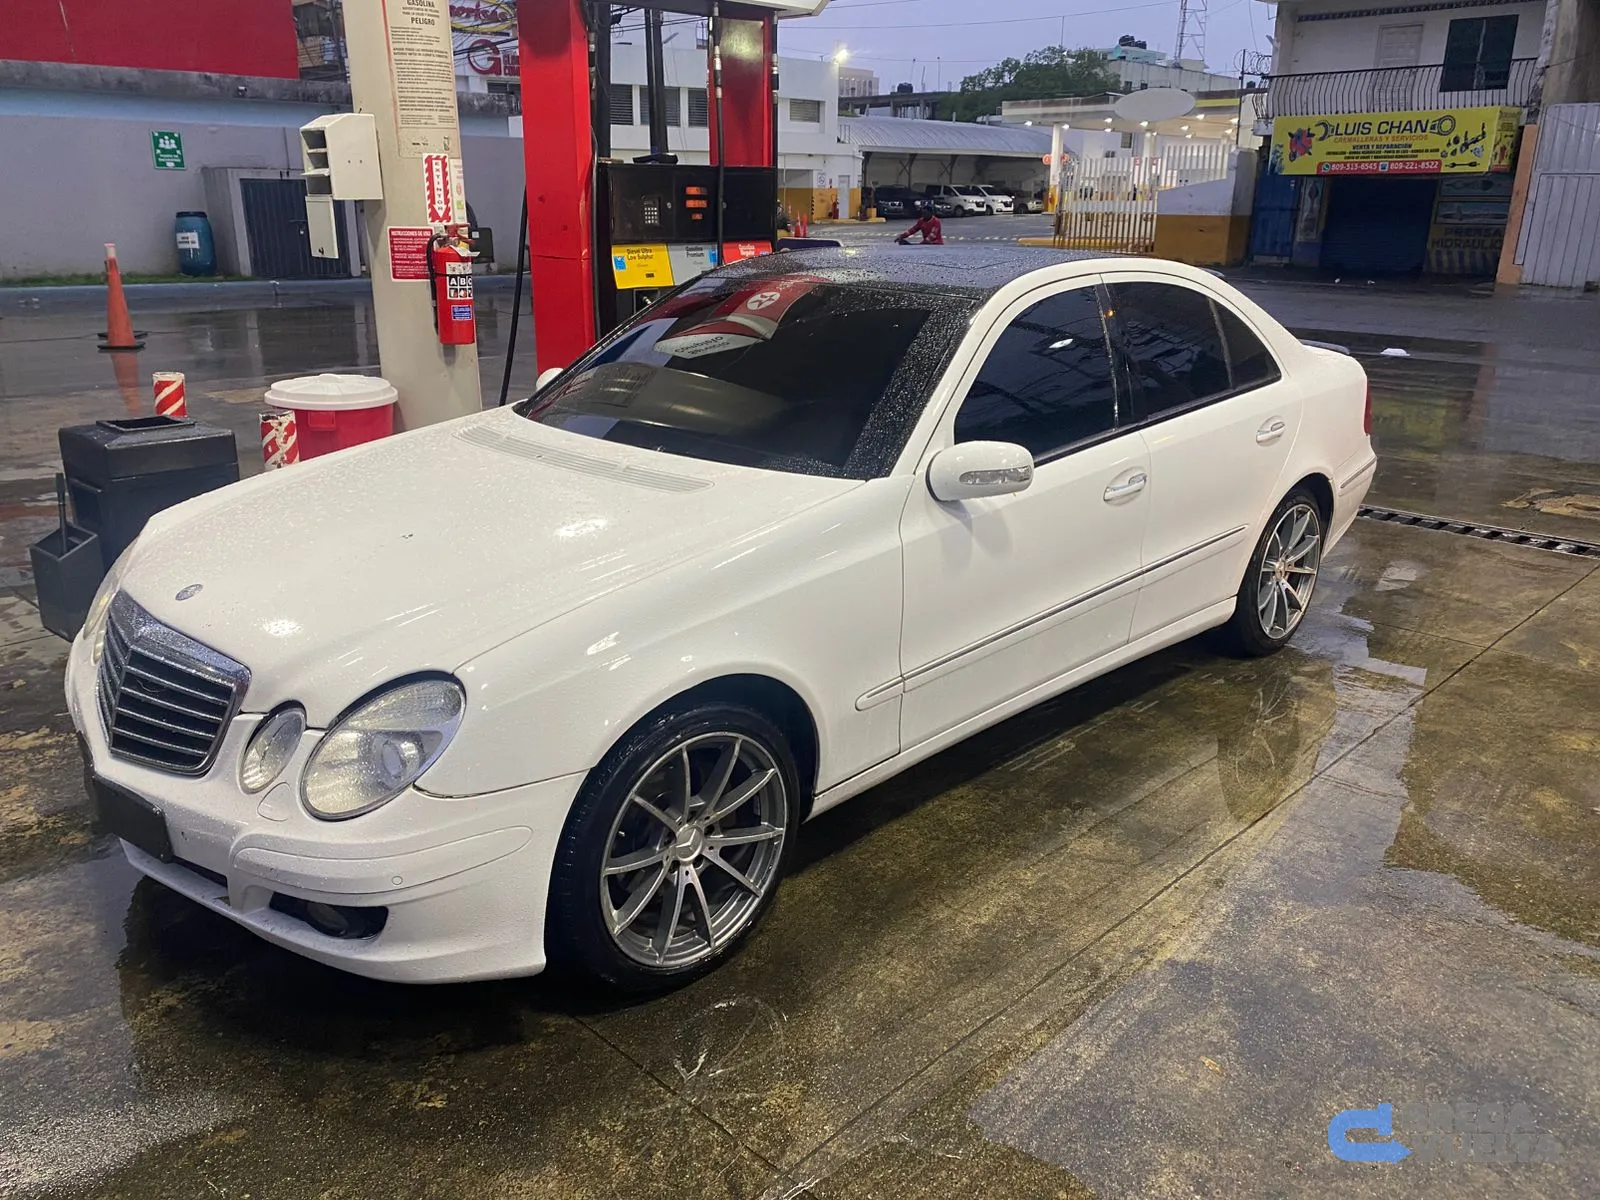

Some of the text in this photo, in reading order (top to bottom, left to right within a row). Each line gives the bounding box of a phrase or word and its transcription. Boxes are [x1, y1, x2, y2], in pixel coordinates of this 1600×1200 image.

[411, 17, 435, 26] PELIGRO
[1335, 122, 1372, 136] LUIS
[1334, 135, 1383, 144] CREMALLERAS
[1391, 134, 1429, 142] SERVICIOS
[434, 161, 443, 210] EXTINTOR
